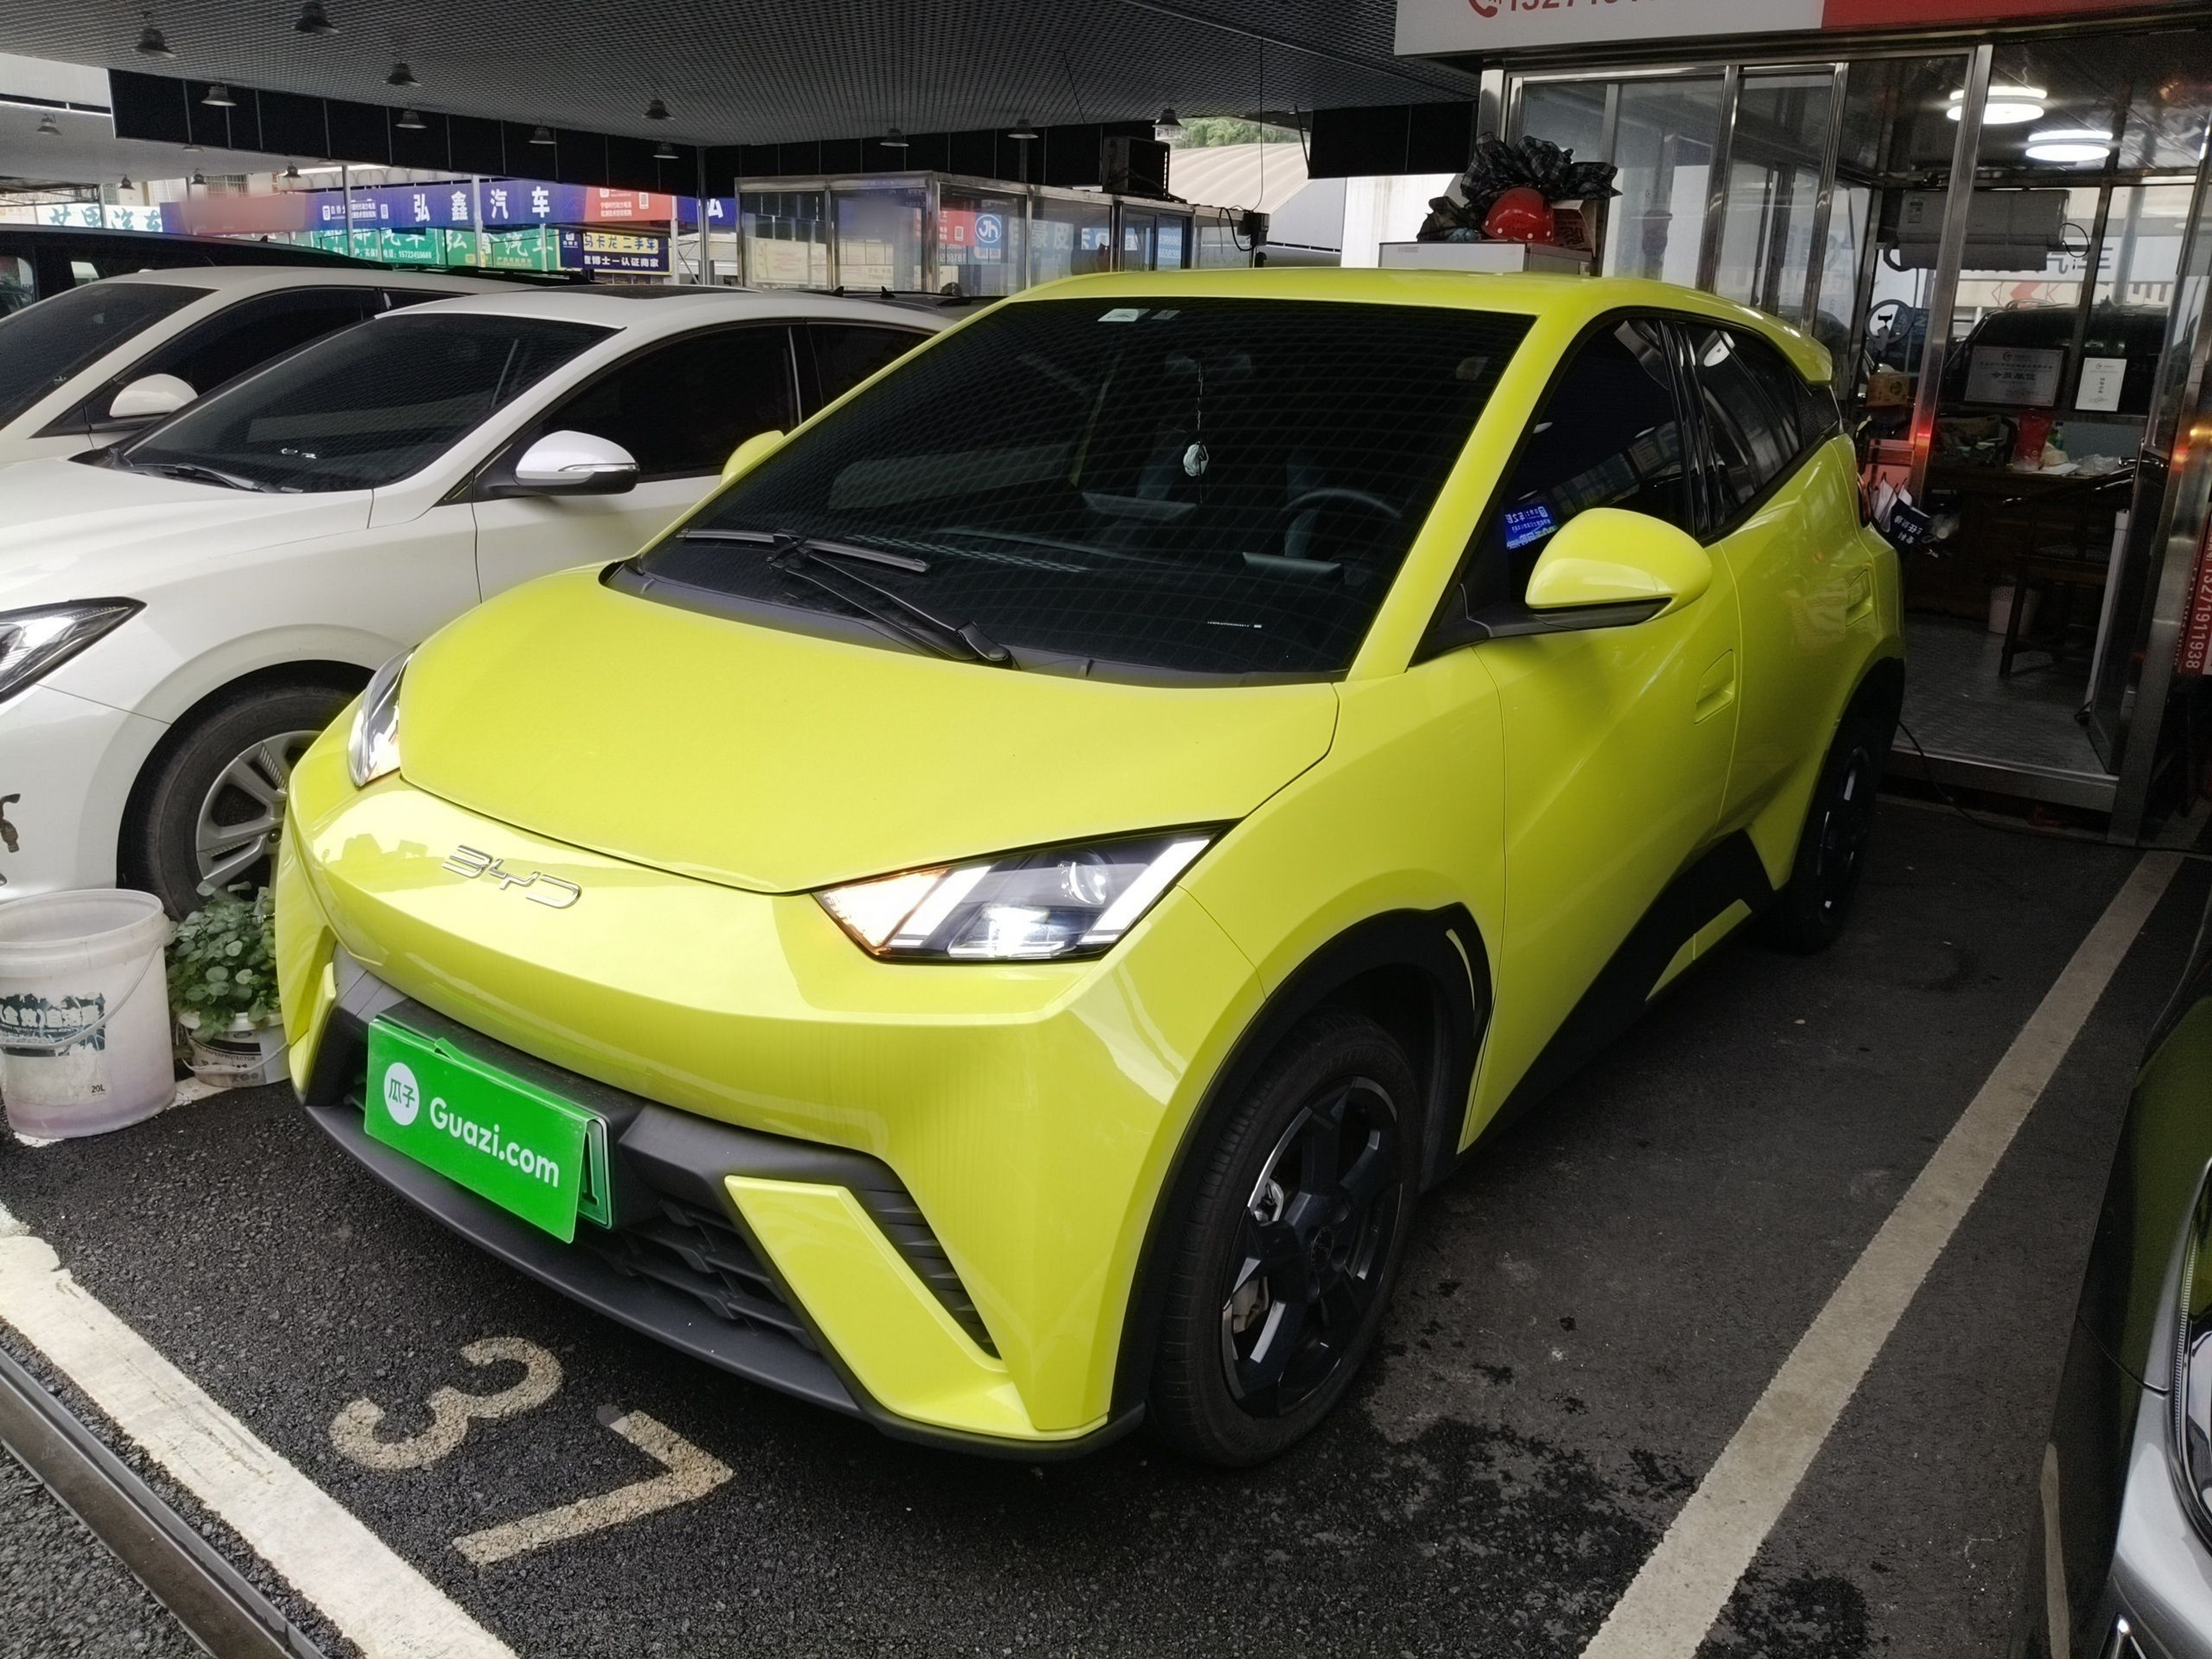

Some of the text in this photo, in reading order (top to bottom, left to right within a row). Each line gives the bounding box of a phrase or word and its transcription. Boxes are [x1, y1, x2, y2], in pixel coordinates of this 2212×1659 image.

[414, 186, 550, 222] 弘鑫汽车
[584, 234, 656, 251] 马卡龙二手车
[442, 844, 582, 910] BYD
[91, 1084, 105, 1093] 20L
[388, 1077, 415, 1109] 瓜子
[430, 1096, 560, 1188] Guazi.com
[329, 1336, 734, 1566] 37
